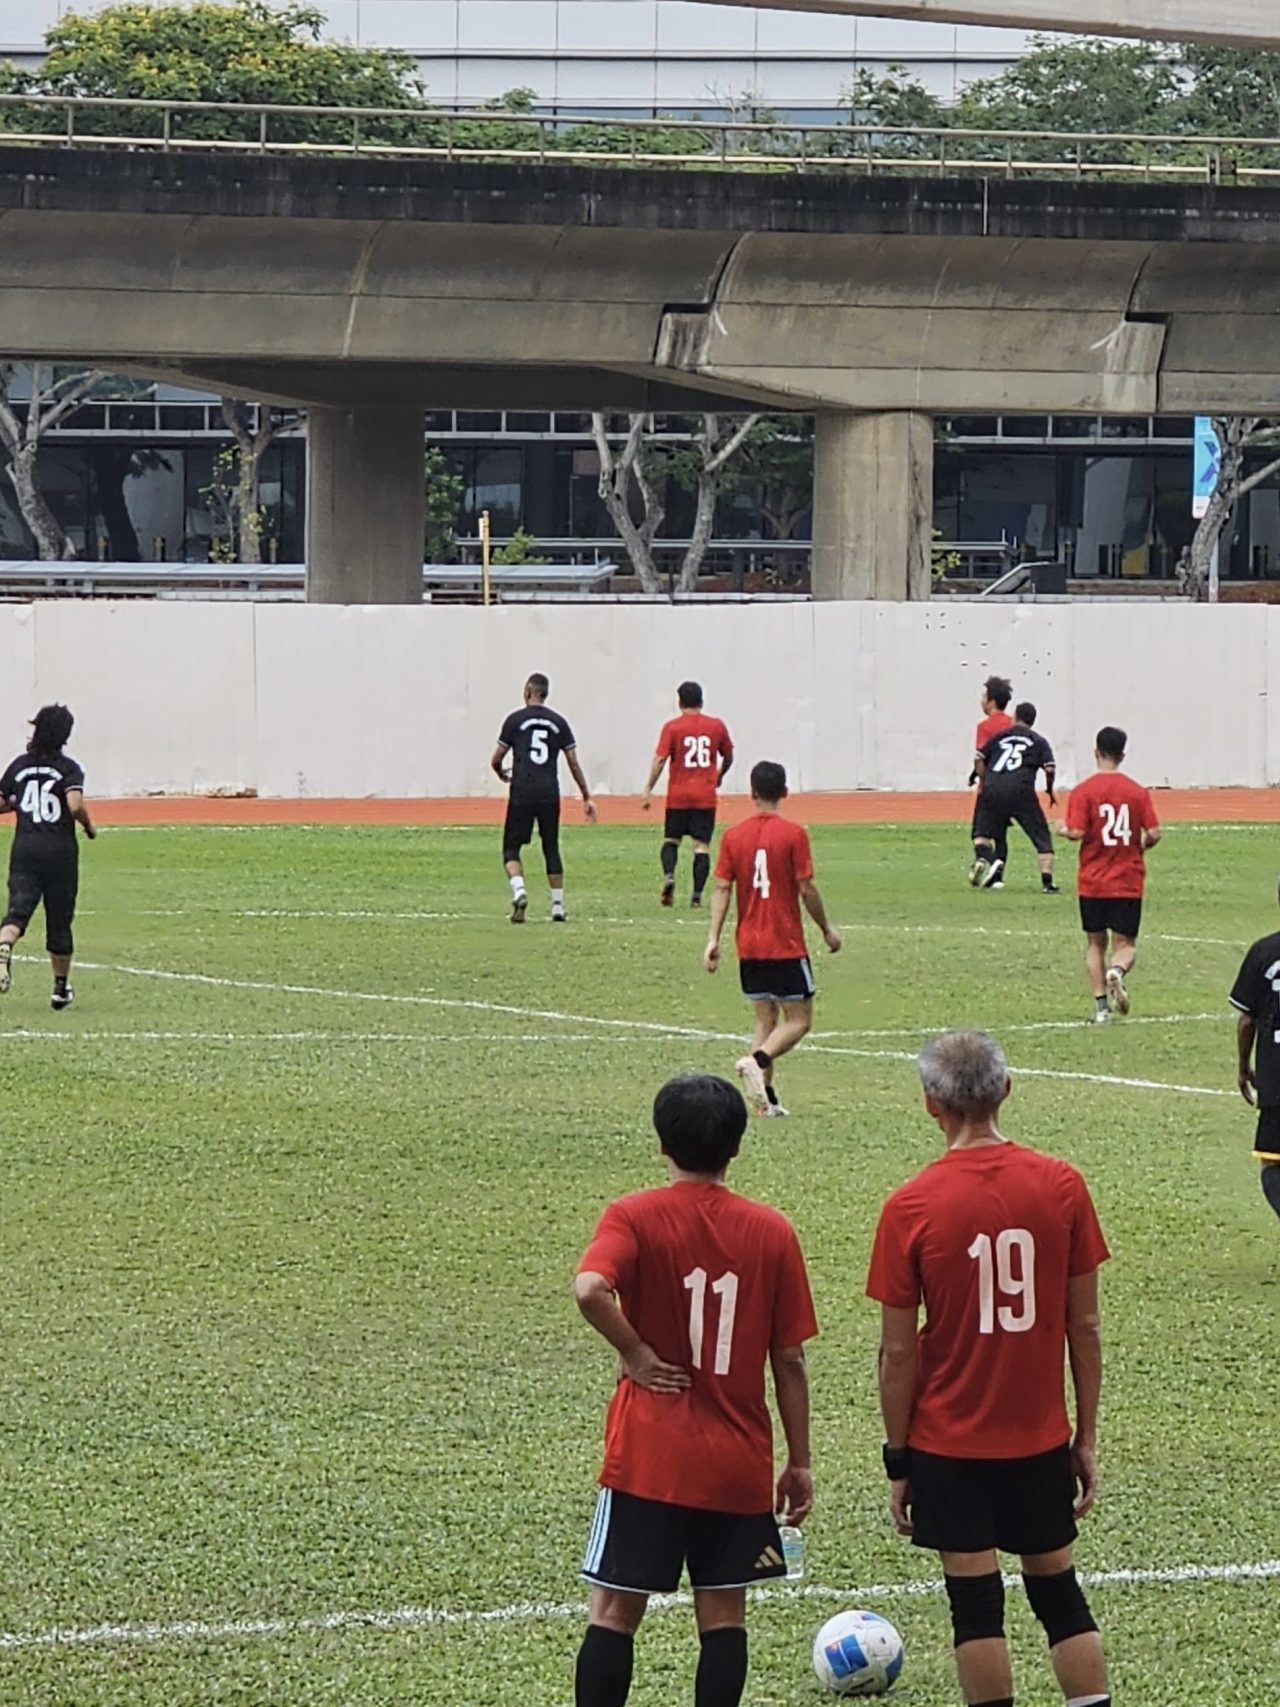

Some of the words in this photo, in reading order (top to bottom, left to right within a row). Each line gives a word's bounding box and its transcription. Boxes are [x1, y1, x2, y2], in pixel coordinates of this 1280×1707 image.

[529, 729, 549, 765] 5
[683, 735, 712, 769] 26
[992, 743, 1027, 772] 75
[19, 780, 62, 823] 46
[1098, 803, 1133, 847] 24
[752, 848, 771, 900] 4
[967, 1228, 1036, 1334] 19
[683, 1267, 739, 1375] 11
